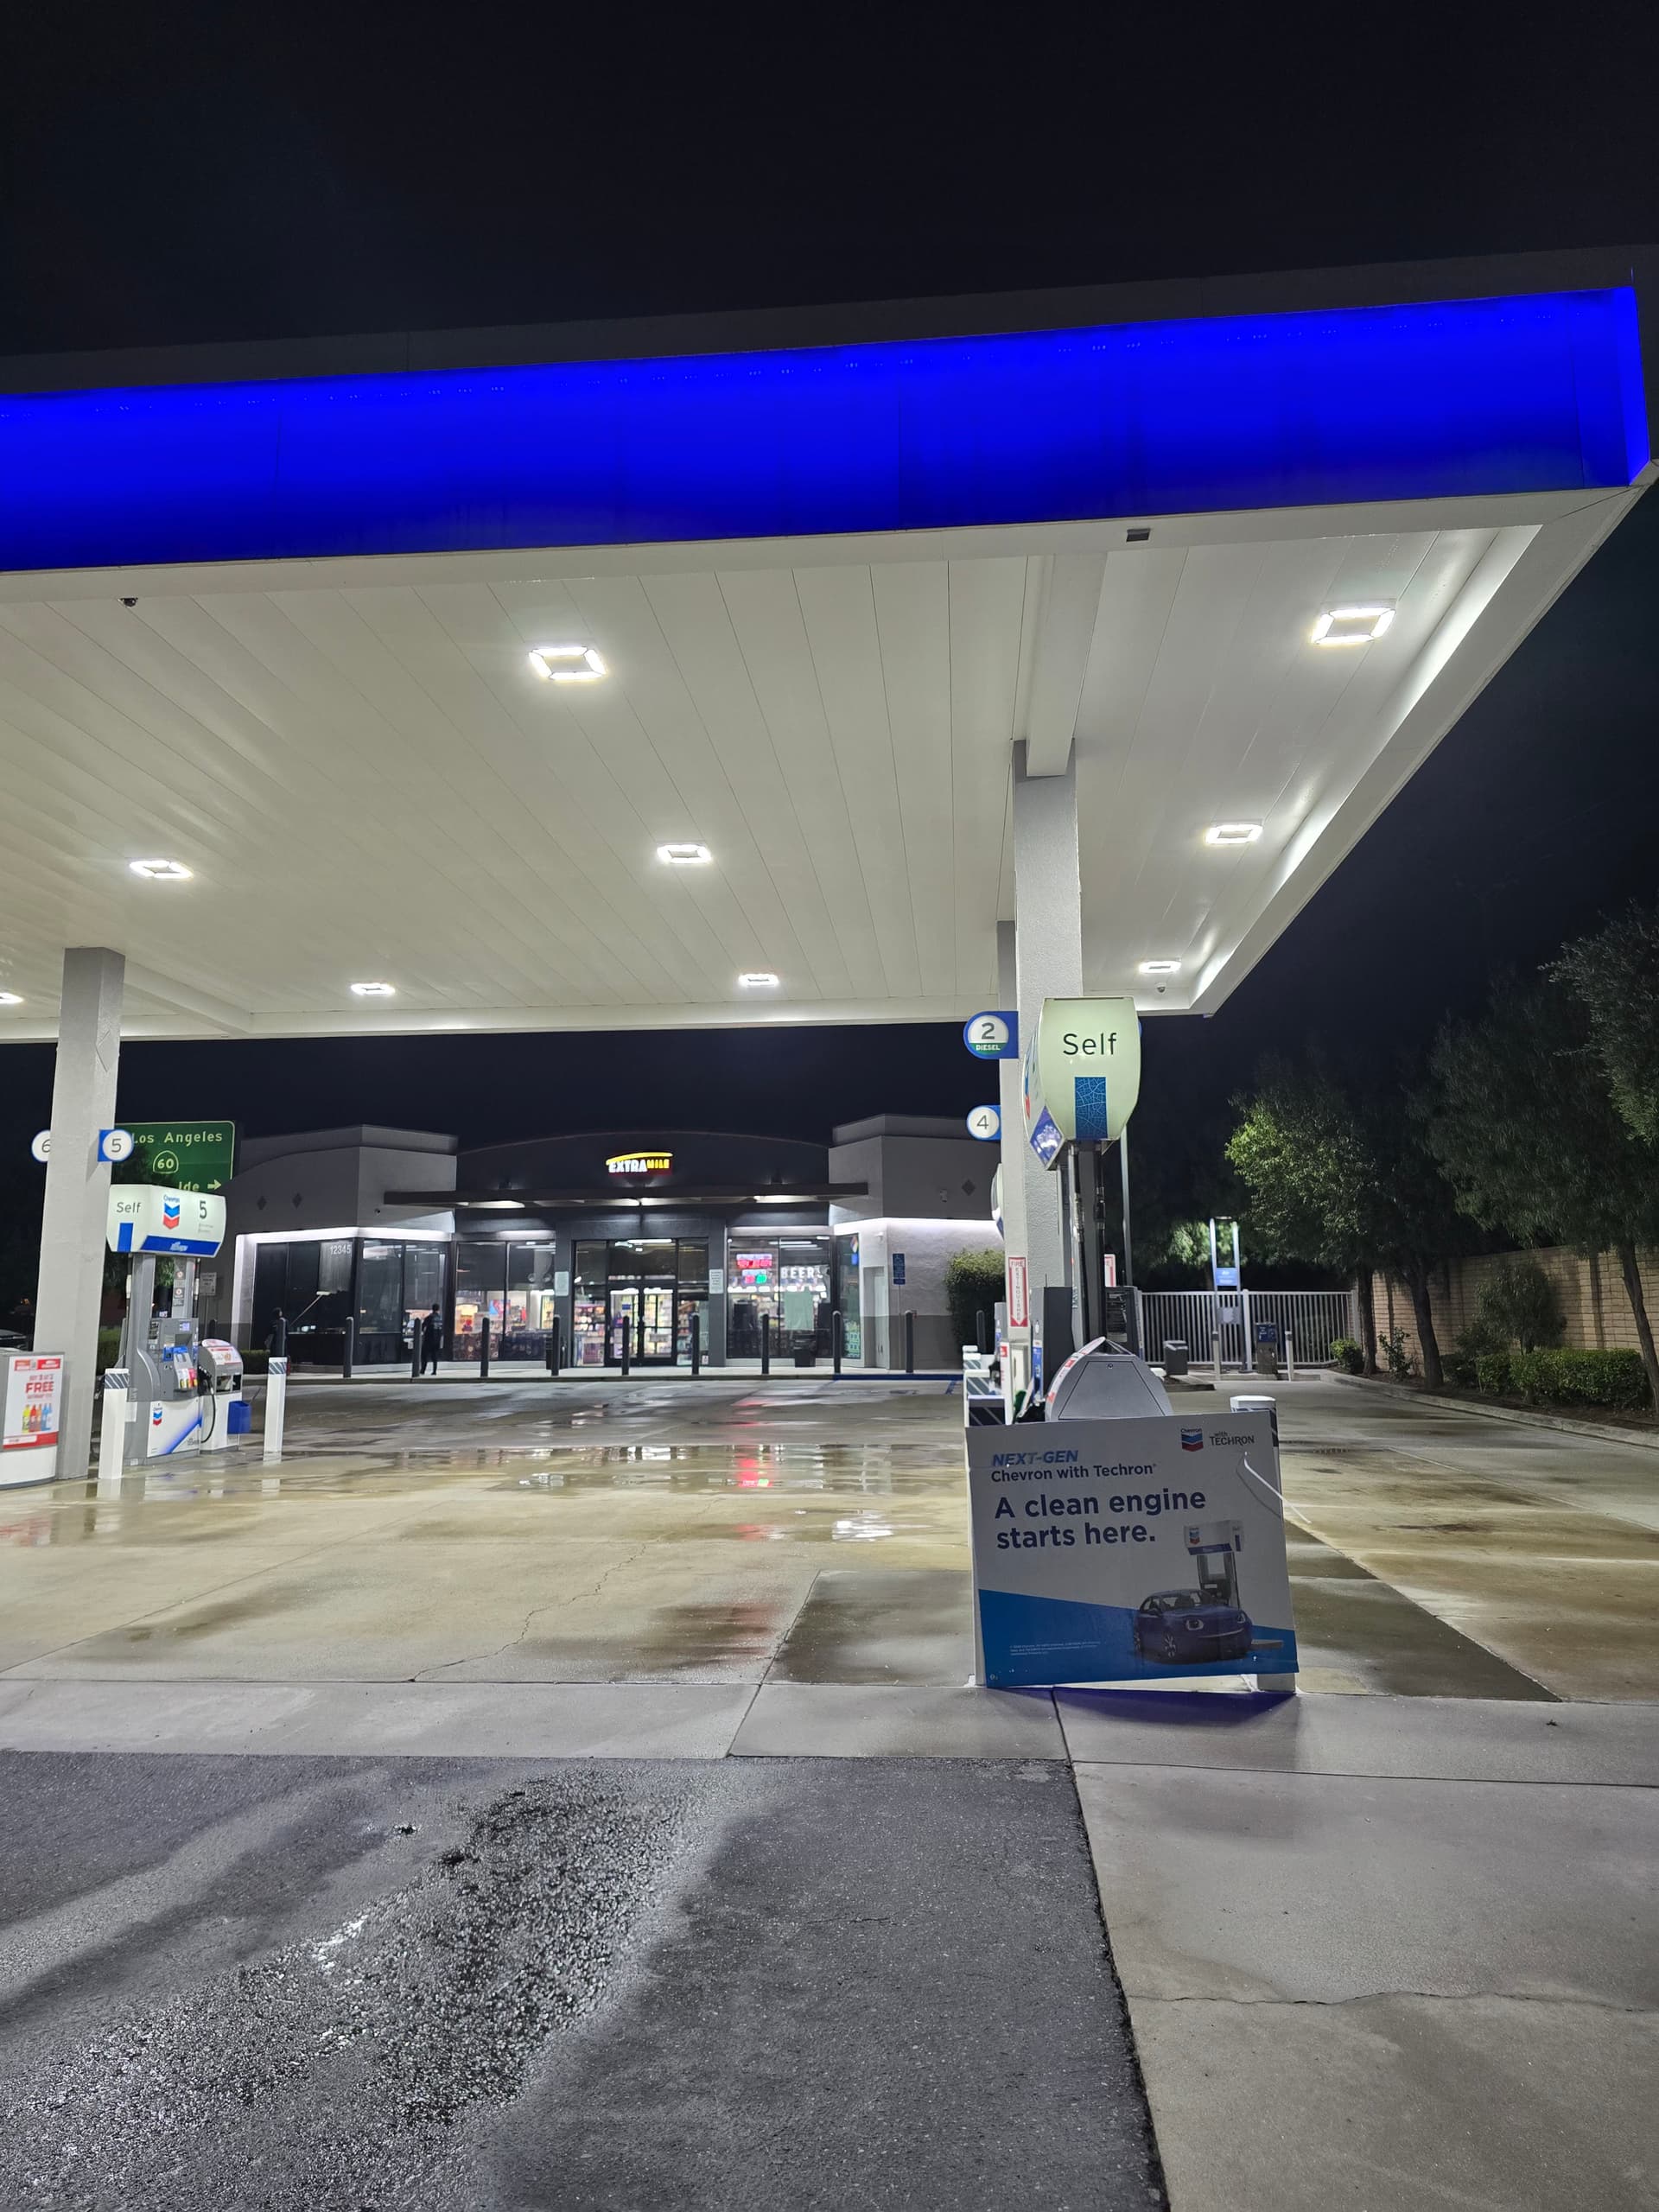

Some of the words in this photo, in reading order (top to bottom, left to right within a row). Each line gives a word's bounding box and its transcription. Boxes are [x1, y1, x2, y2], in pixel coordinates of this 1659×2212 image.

[981, 1022, 995, 1039] 2
[1063, 1033, 1117, 1055] Self
[976, 1115, 989, 1129] 4
[111, 1138, 122, 1153] 5
[131, 1133, 155, 1144] Los
[164, 1131, 223, 1147] Angeles
[157, 1159, 175, 1169] 60
[116, 1202, 142, 1213] Self
[199, 1200, 207, 1219] 5
[25, 1381, 54, 1393] FREE
[1210, 1435, 1255, 1446] TECHRON
[992, 1450, 1079, 1467] NEXT-GEN
[991, 1469, 1053, 1482] Chevron
[1057, 1465, 1089, 1478] with
[995, 1497, 1015, 1518] A
[1025, 1494, 1099, 1517] clean
[1109, 1488, 1206, 1516] engine
[996, 1526, 1075, 1549] starts
[1084, 1522, 1155, 1544] here.
